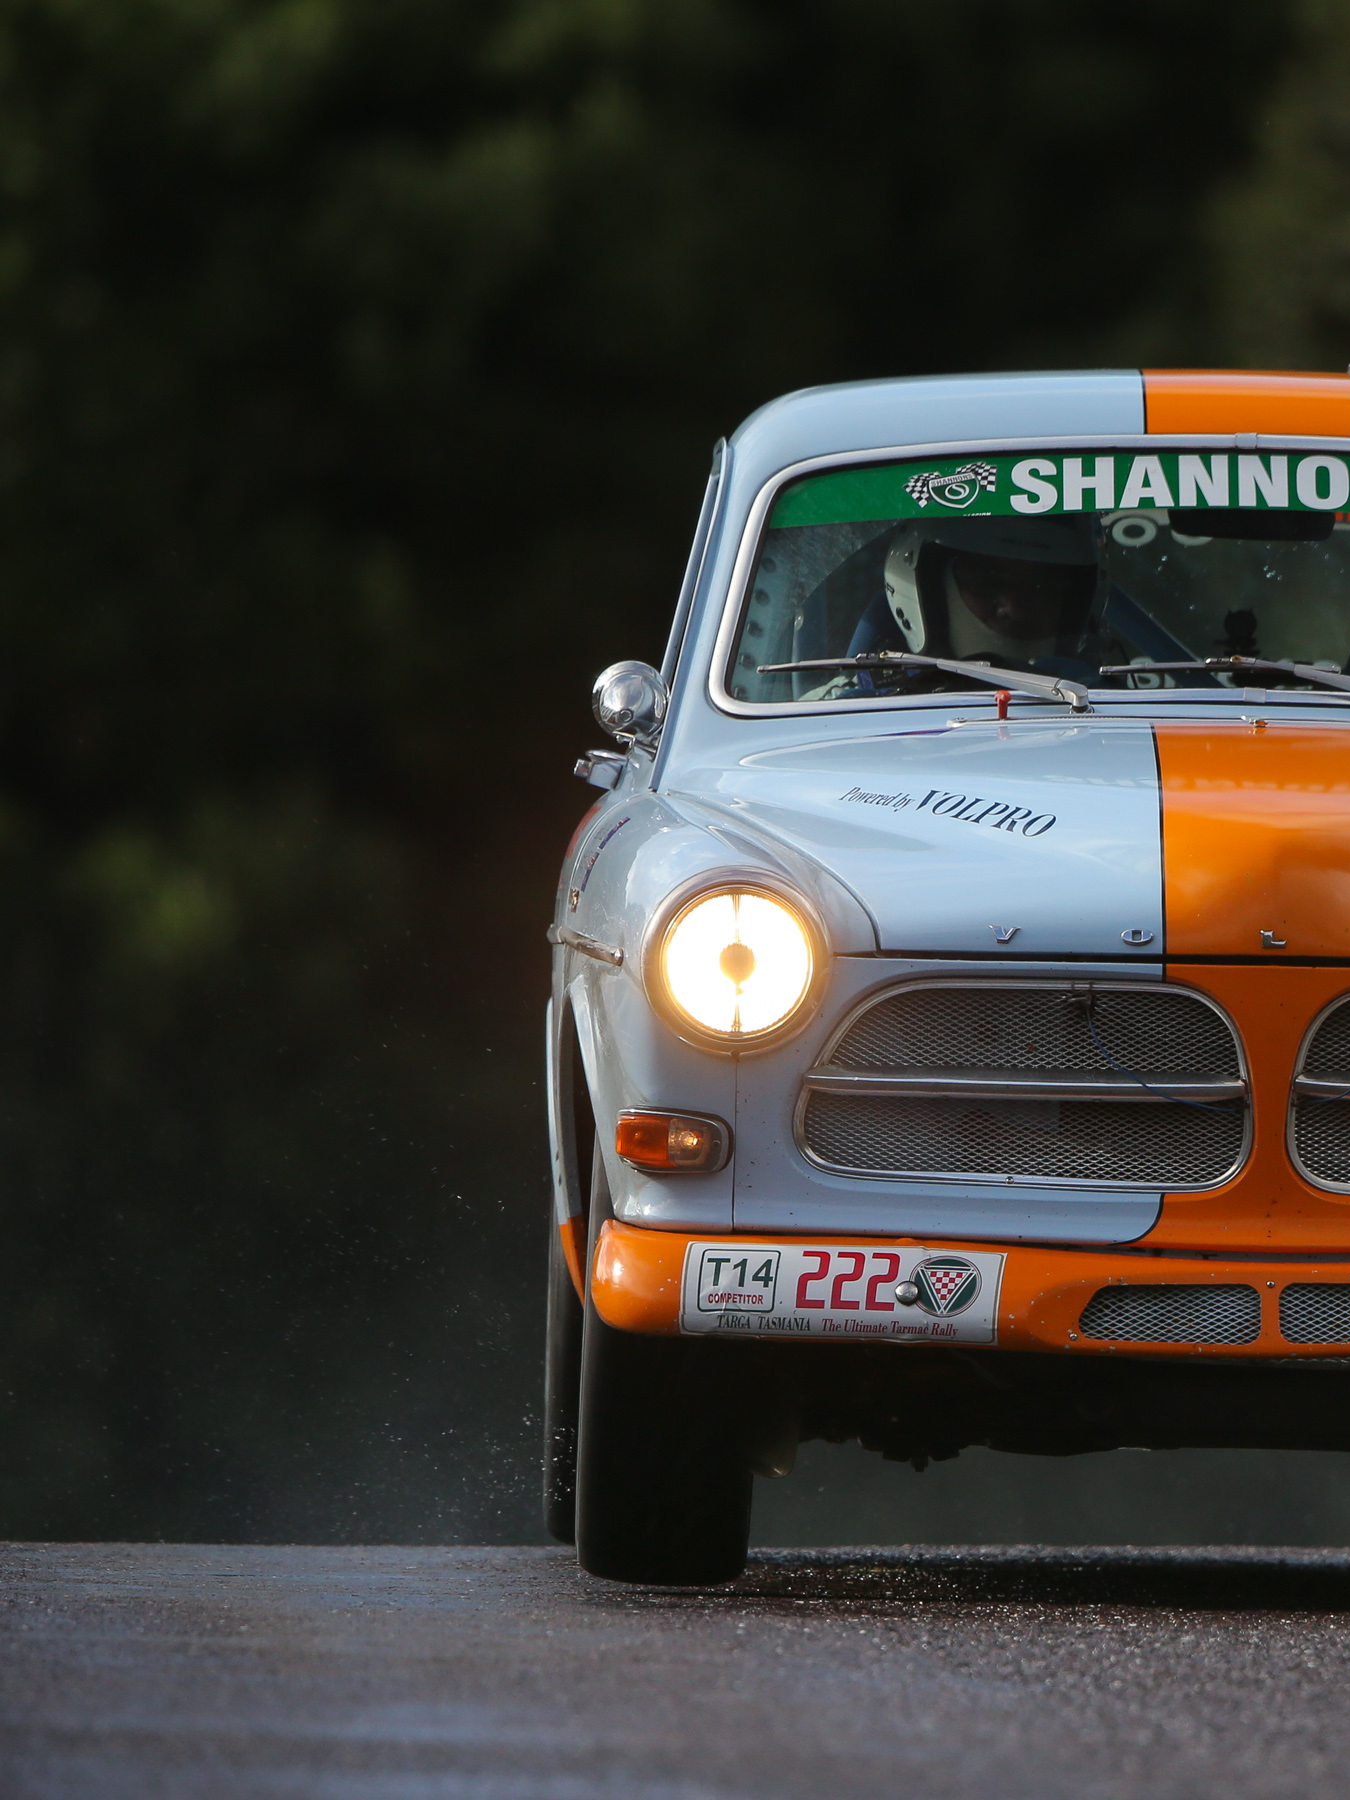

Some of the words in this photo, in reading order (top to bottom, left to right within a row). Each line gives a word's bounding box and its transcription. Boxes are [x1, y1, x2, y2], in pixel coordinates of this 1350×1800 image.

[838, 786, 896, 806] Powered
[893, 792, 916, 812] by
[915, 789, 1057, 838] VOLPRO
[706, 1257, 774, 1289] T14
[795, 1250, 901, 1312] 222
[707, 1293, 764, 1305] COMPETITOR
[716, 1314, 751, 1330] TARGA
[757, 1316, 811, 1332] TASMANIA
[821, 1318, 841, 1332] The
[844, 1320, 888, 1334] Ultimate
[890, 1321, 929, 1335] Tarmac
[930, 1322, 959, 1339] Rally
